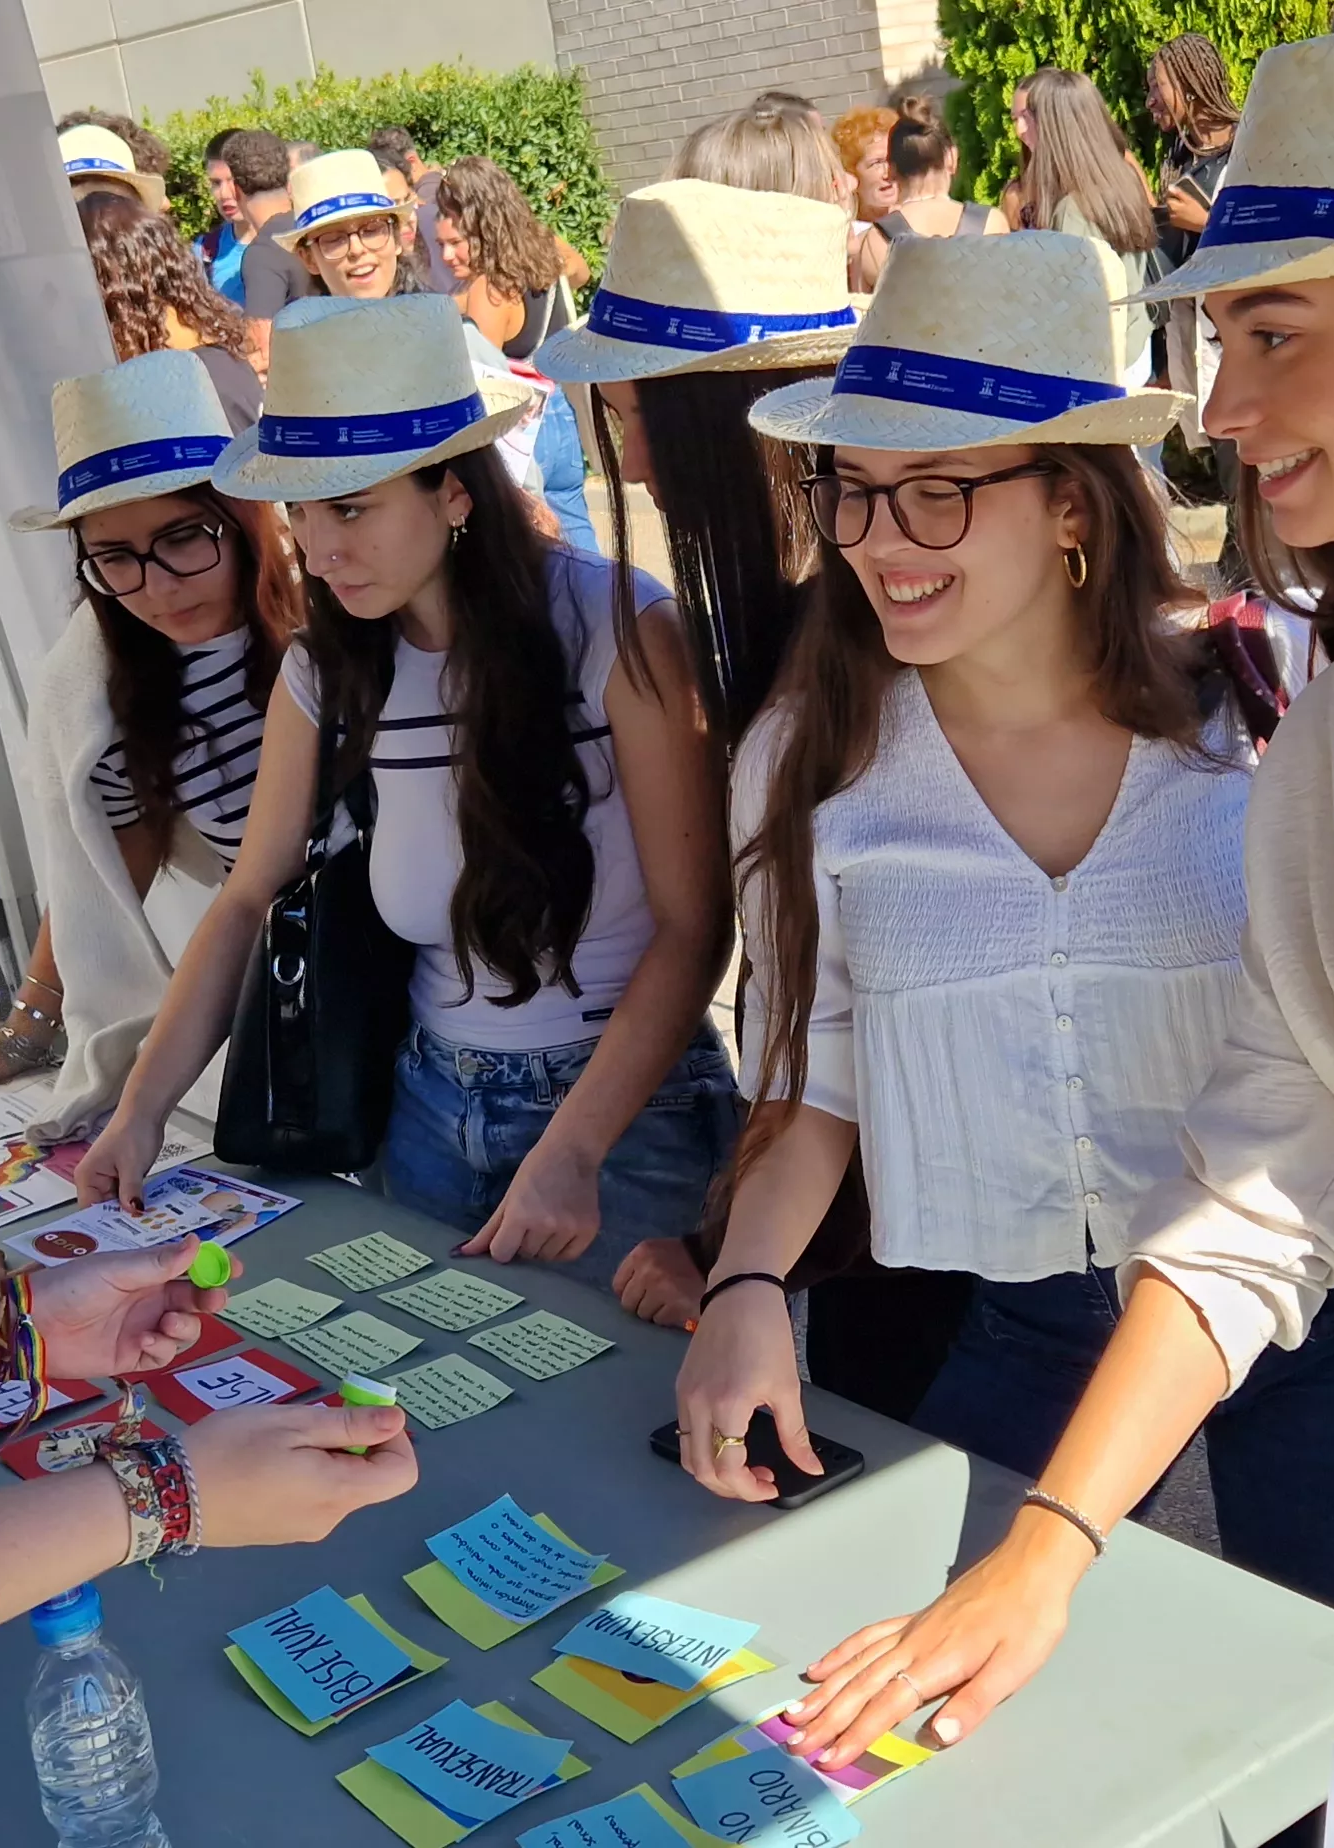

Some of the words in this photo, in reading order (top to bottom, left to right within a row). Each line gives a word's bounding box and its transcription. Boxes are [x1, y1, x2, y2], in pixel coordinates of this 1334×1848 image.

[263, 1607, 375, 1706] BISEXUAL
[585, 1608, 731, 1669] INTERSEXUAL
[405, 1723, 535, 1799] TRANSEXUAL
[719, 1811, 761, 1845] NO
[748, 1768, 831, 1848] BINARIO
